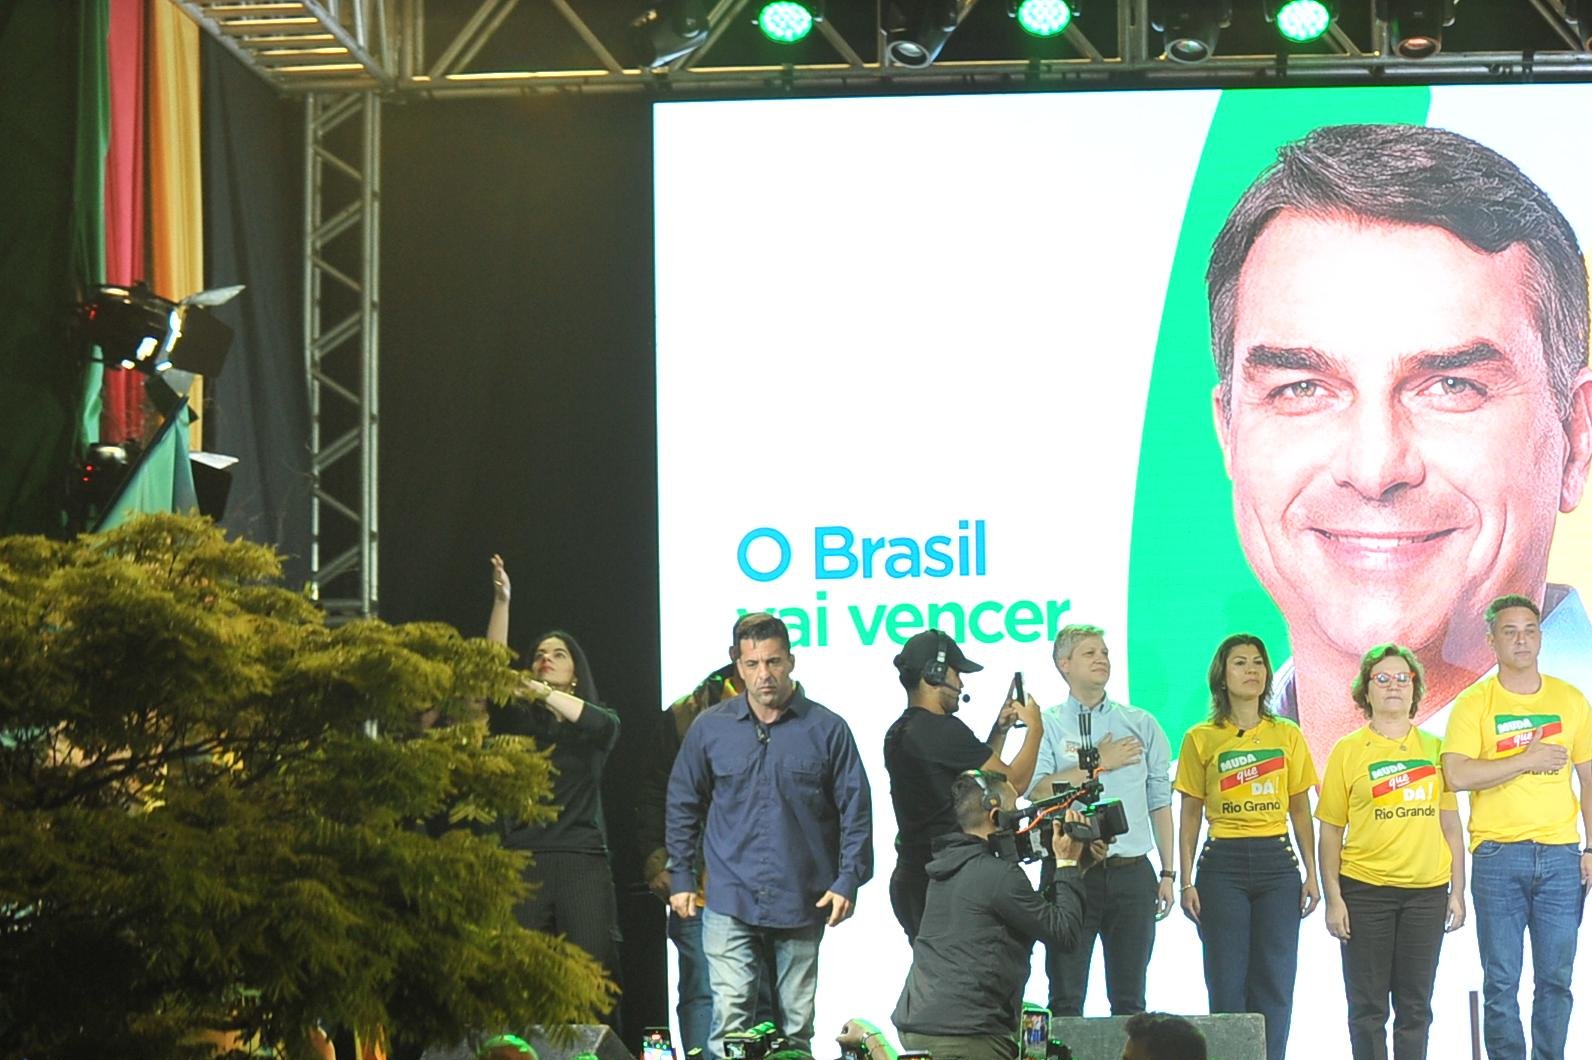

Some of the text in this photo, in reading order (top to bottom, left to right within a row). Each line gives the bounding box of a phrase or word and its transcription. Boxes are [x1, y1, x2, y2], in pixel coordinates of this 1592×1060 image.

[737, 520, 986, 582] O Brasil
[848, 599, 1071, 646] vencer
[1221, 754, 1257, 771] MUDA
[1371, 762, 1407, 780] MUDA
[1237, 767, 1258, 784] que
[1389, 774, 1410, 790] que
[1222, 801, 1242, 814] Rio
[1375, 808, 1394, 820] Rio
